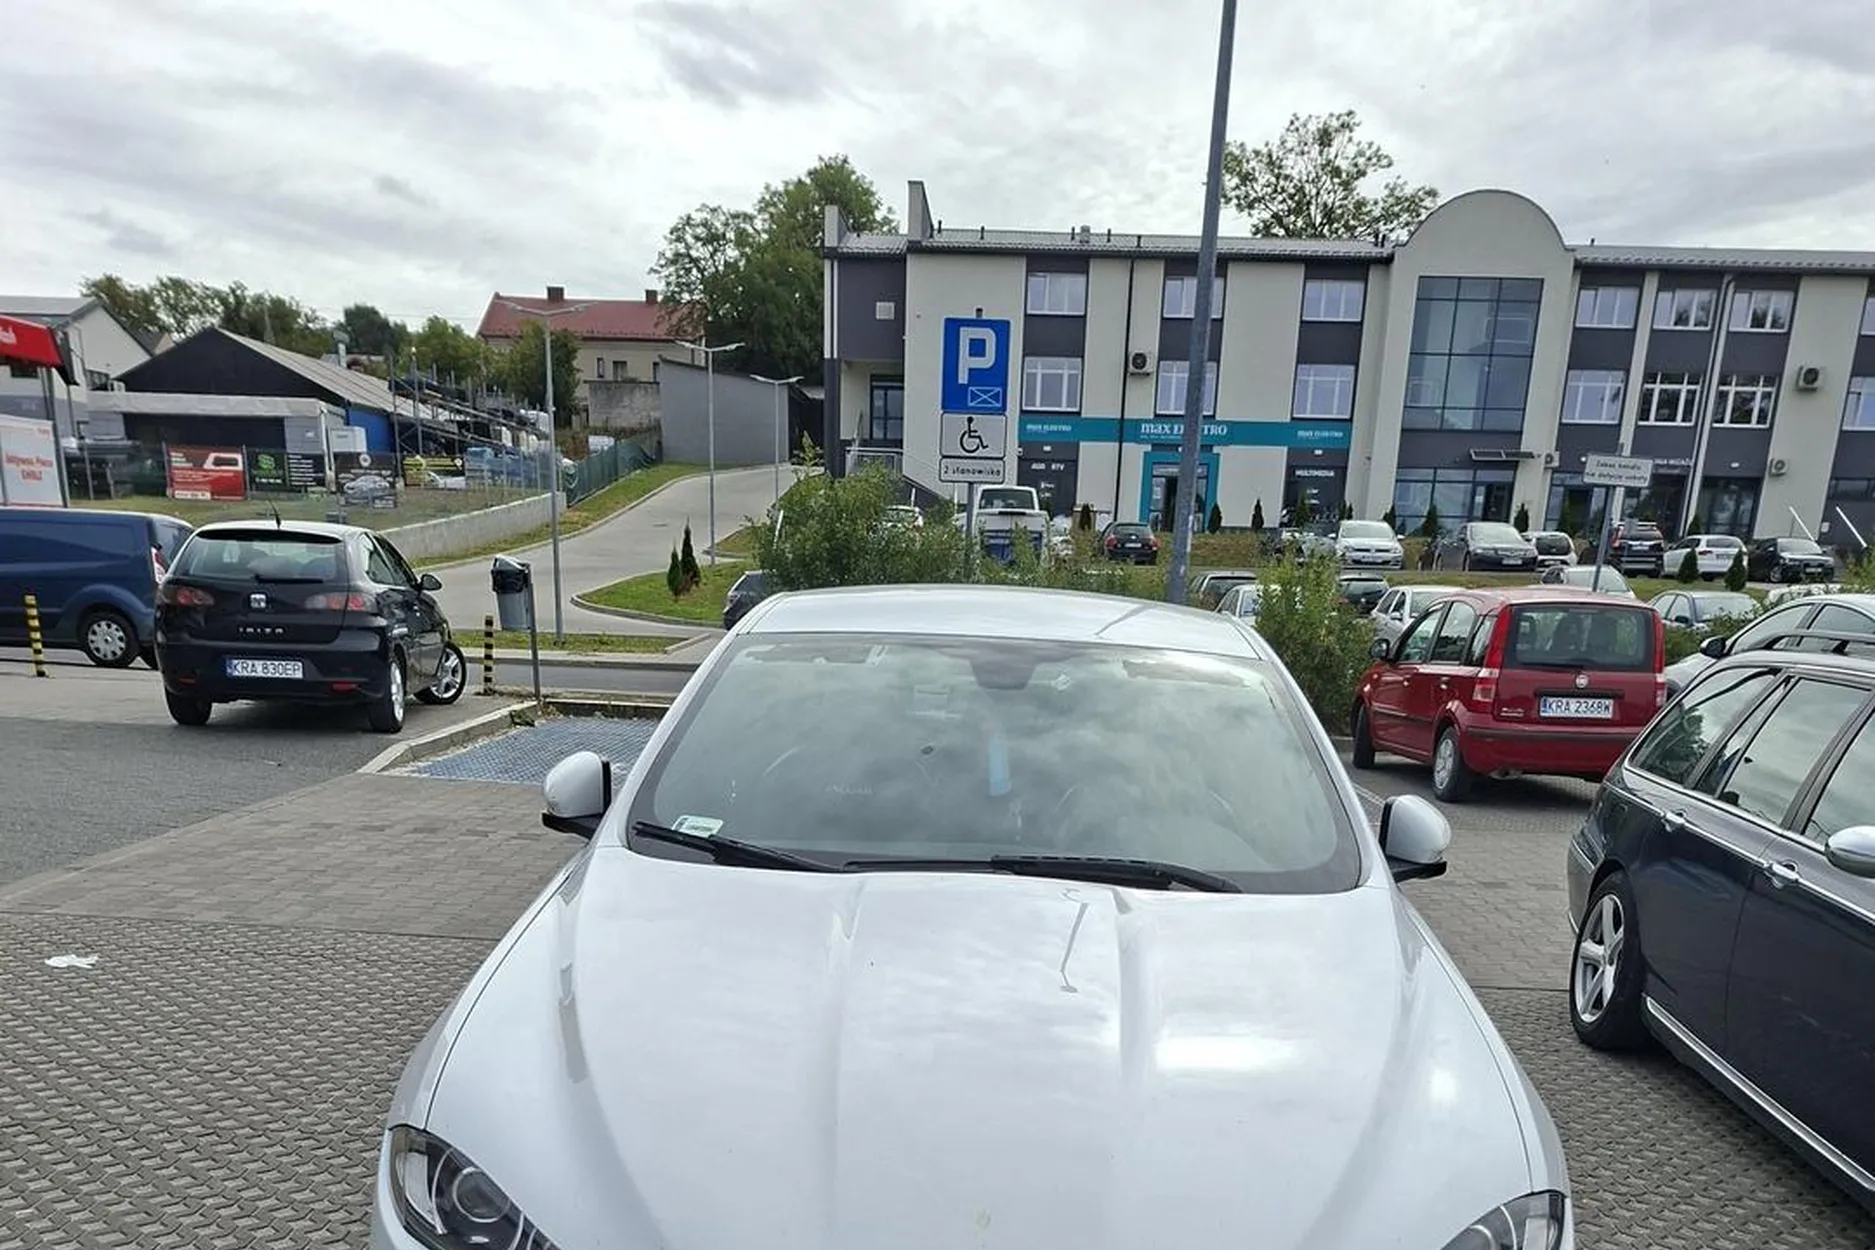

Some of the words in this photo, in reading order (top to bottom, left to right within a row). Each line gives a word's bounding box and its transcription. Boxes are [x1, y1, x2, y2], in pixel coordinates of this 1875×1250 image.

[958, 327, 996, 384] P
[1141, 423, 1170, 434] max
[943, 465, 949, 475] 2
[952, 465, 1001, 477] stanowiska
[233, 661, 258, 674] KRA
[1548, 699, 1571, 713] KRA
[1573, 701, 1611, 715] 2368W
